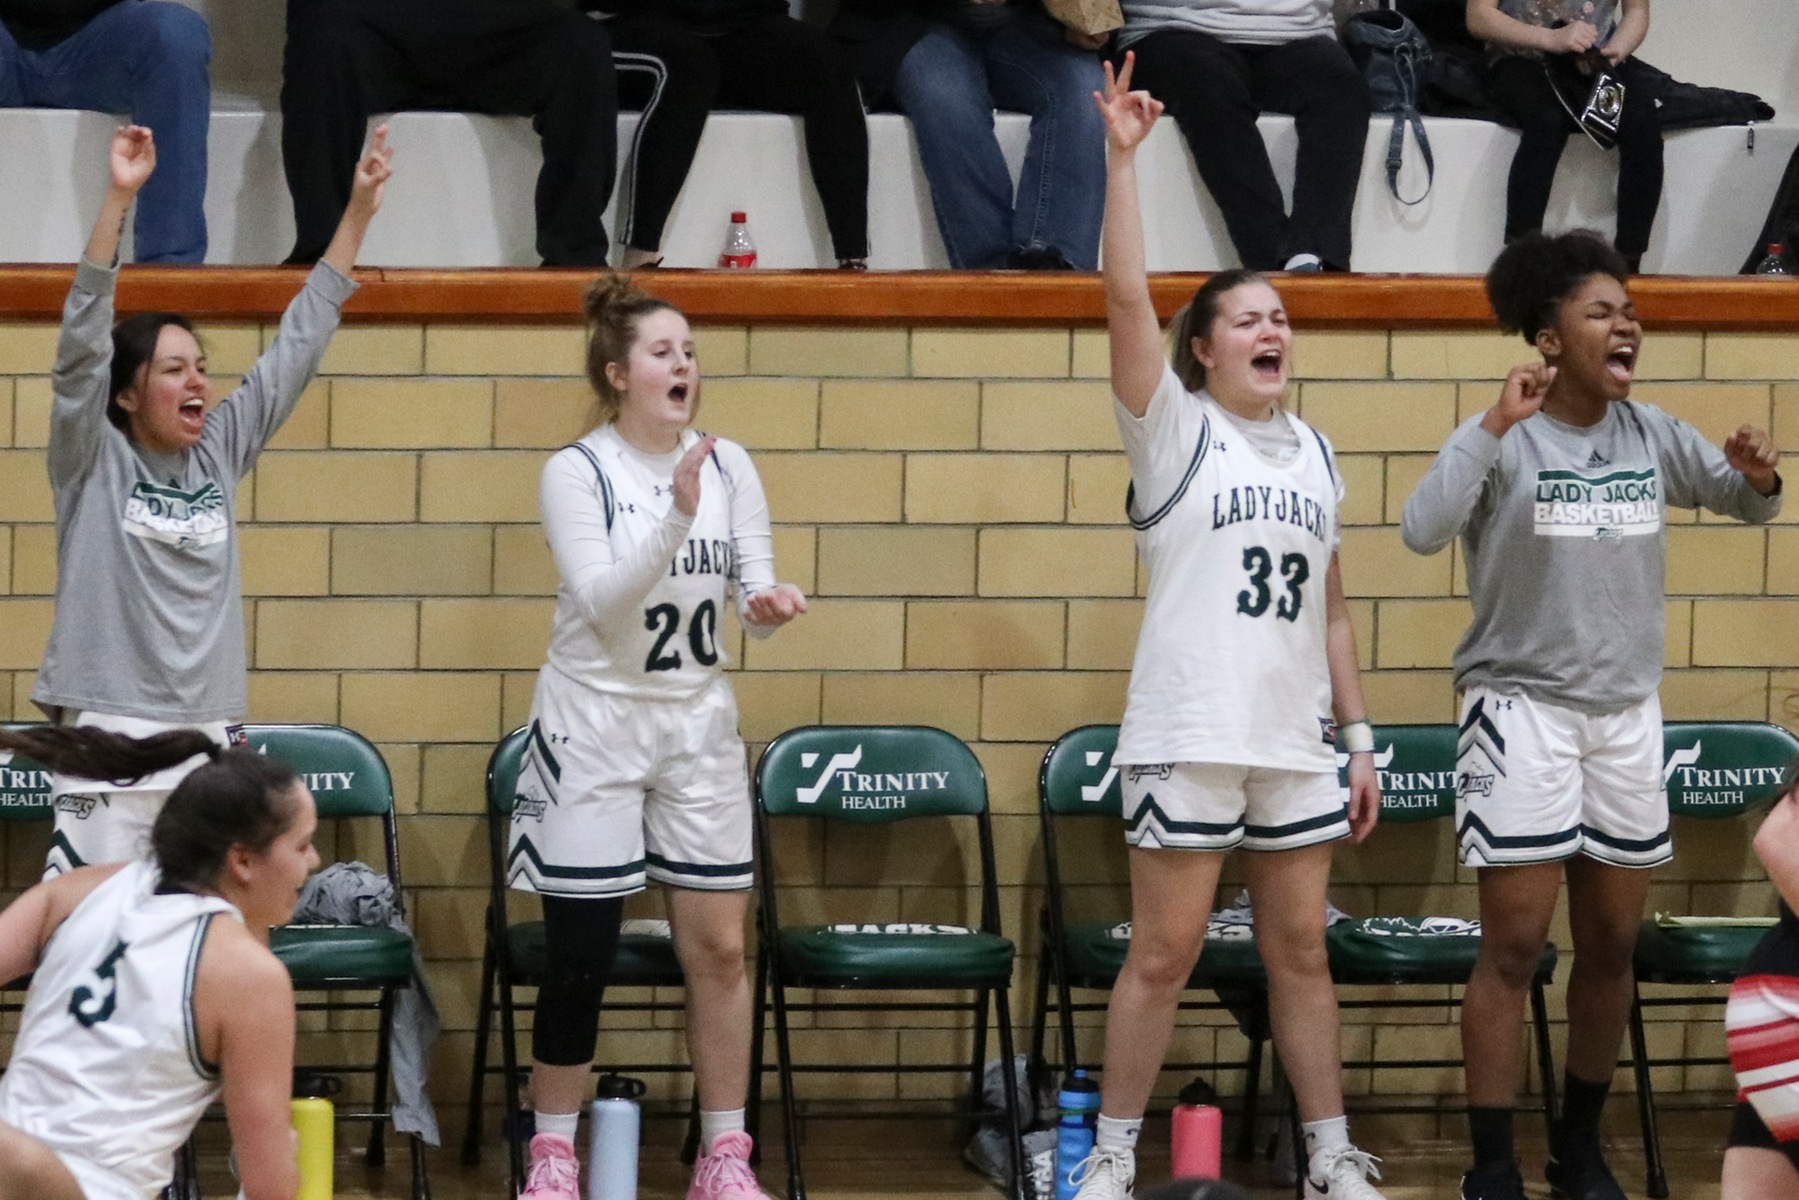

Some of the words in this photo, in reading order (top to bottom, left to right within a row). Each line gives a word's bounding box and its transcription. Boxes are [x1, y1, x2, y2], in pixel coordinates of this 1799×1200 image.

[1536, 483, 1592, 502] LADY
[1212, 485, 1327, 542] LADYJACK
[1237, 546, 1310, 623] 33
[645, 599, 719, 673] 20
[836, 771, 950, 792] TRINITY
[1677, 766, 1786, 787] TRINITY
[842, 796, 906, 810] HEALTH
[1683, 791, 1744, 805] HEALTH
[68, 939, 128, 1028] 5
